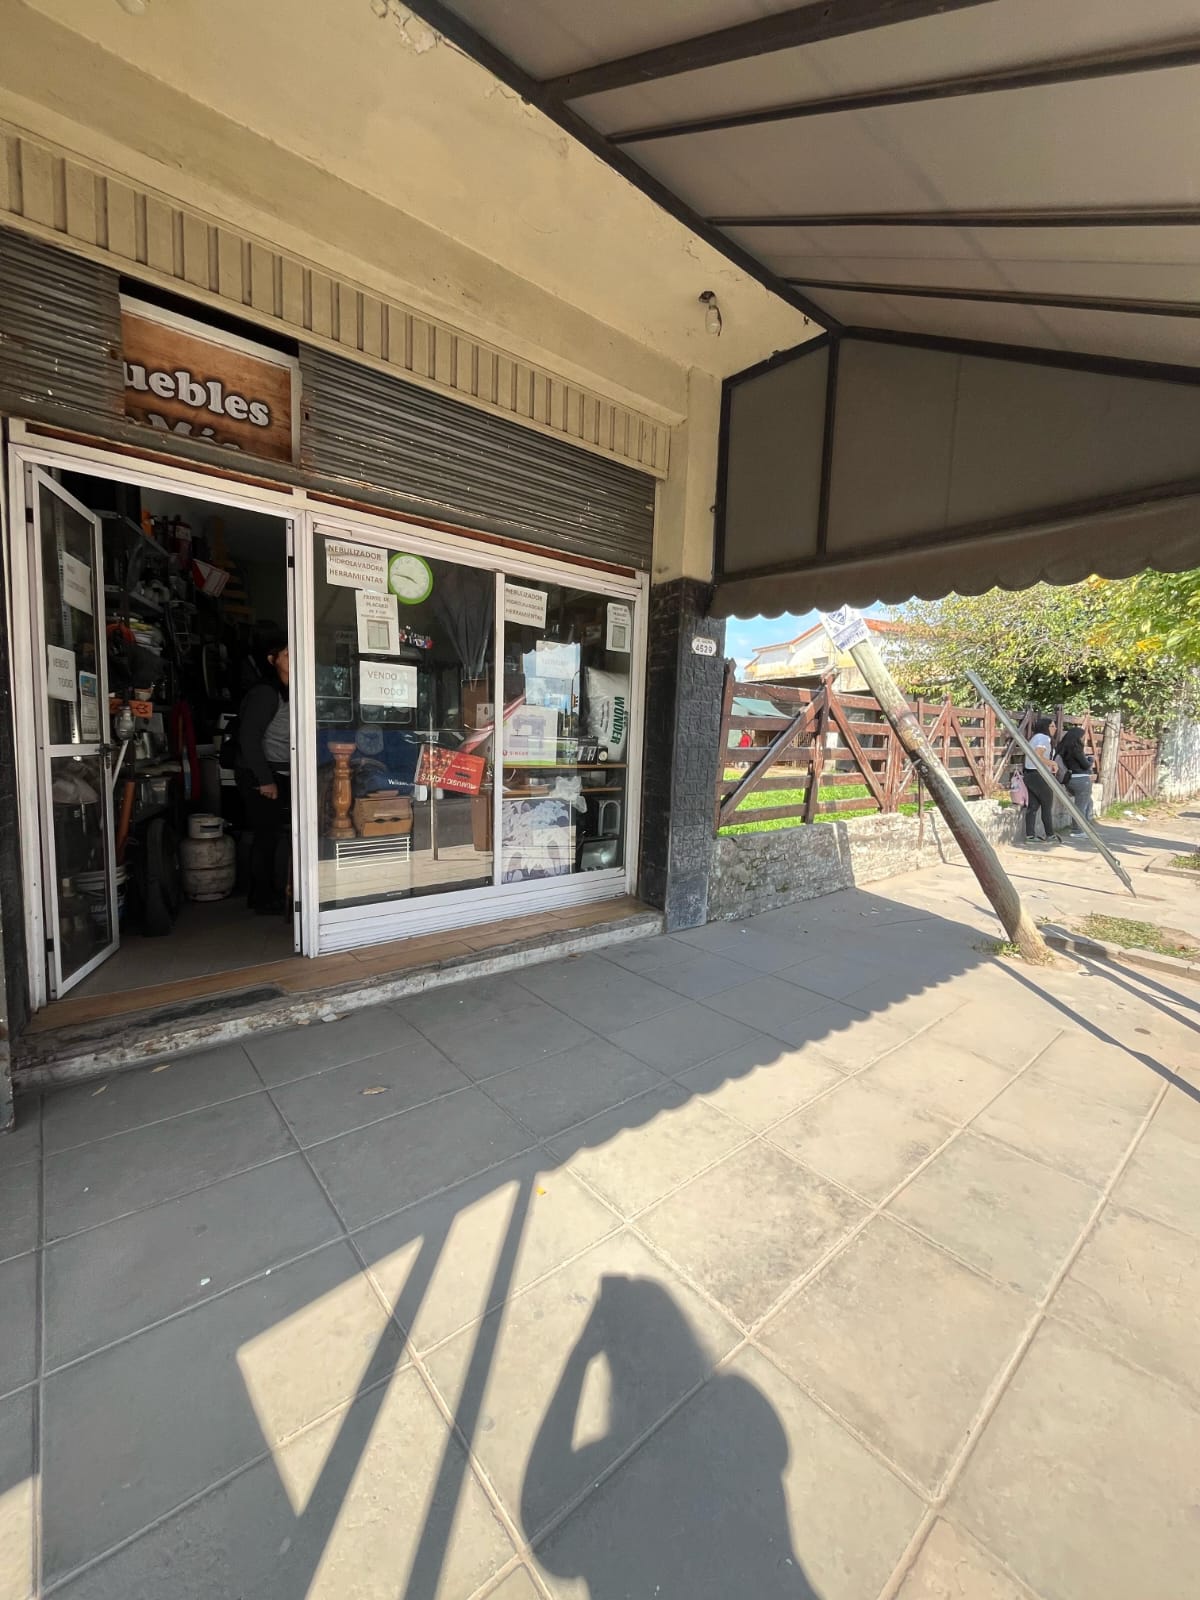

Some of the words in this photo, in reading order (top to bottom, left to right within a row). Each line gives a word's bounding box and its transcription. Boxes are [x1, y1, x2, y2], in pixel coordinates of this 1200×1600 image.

[328, 544, 382, 561] NEBULIZADOR
[329, 555, 384, 573] HIDROLAVADORA
[329, 567, 384, 585] HERRAMIENTAS
[367, 670, 398, 681] VENDO
[379, 686, 404, 697] TODO
[610, 696, 625, 745] WONDER
